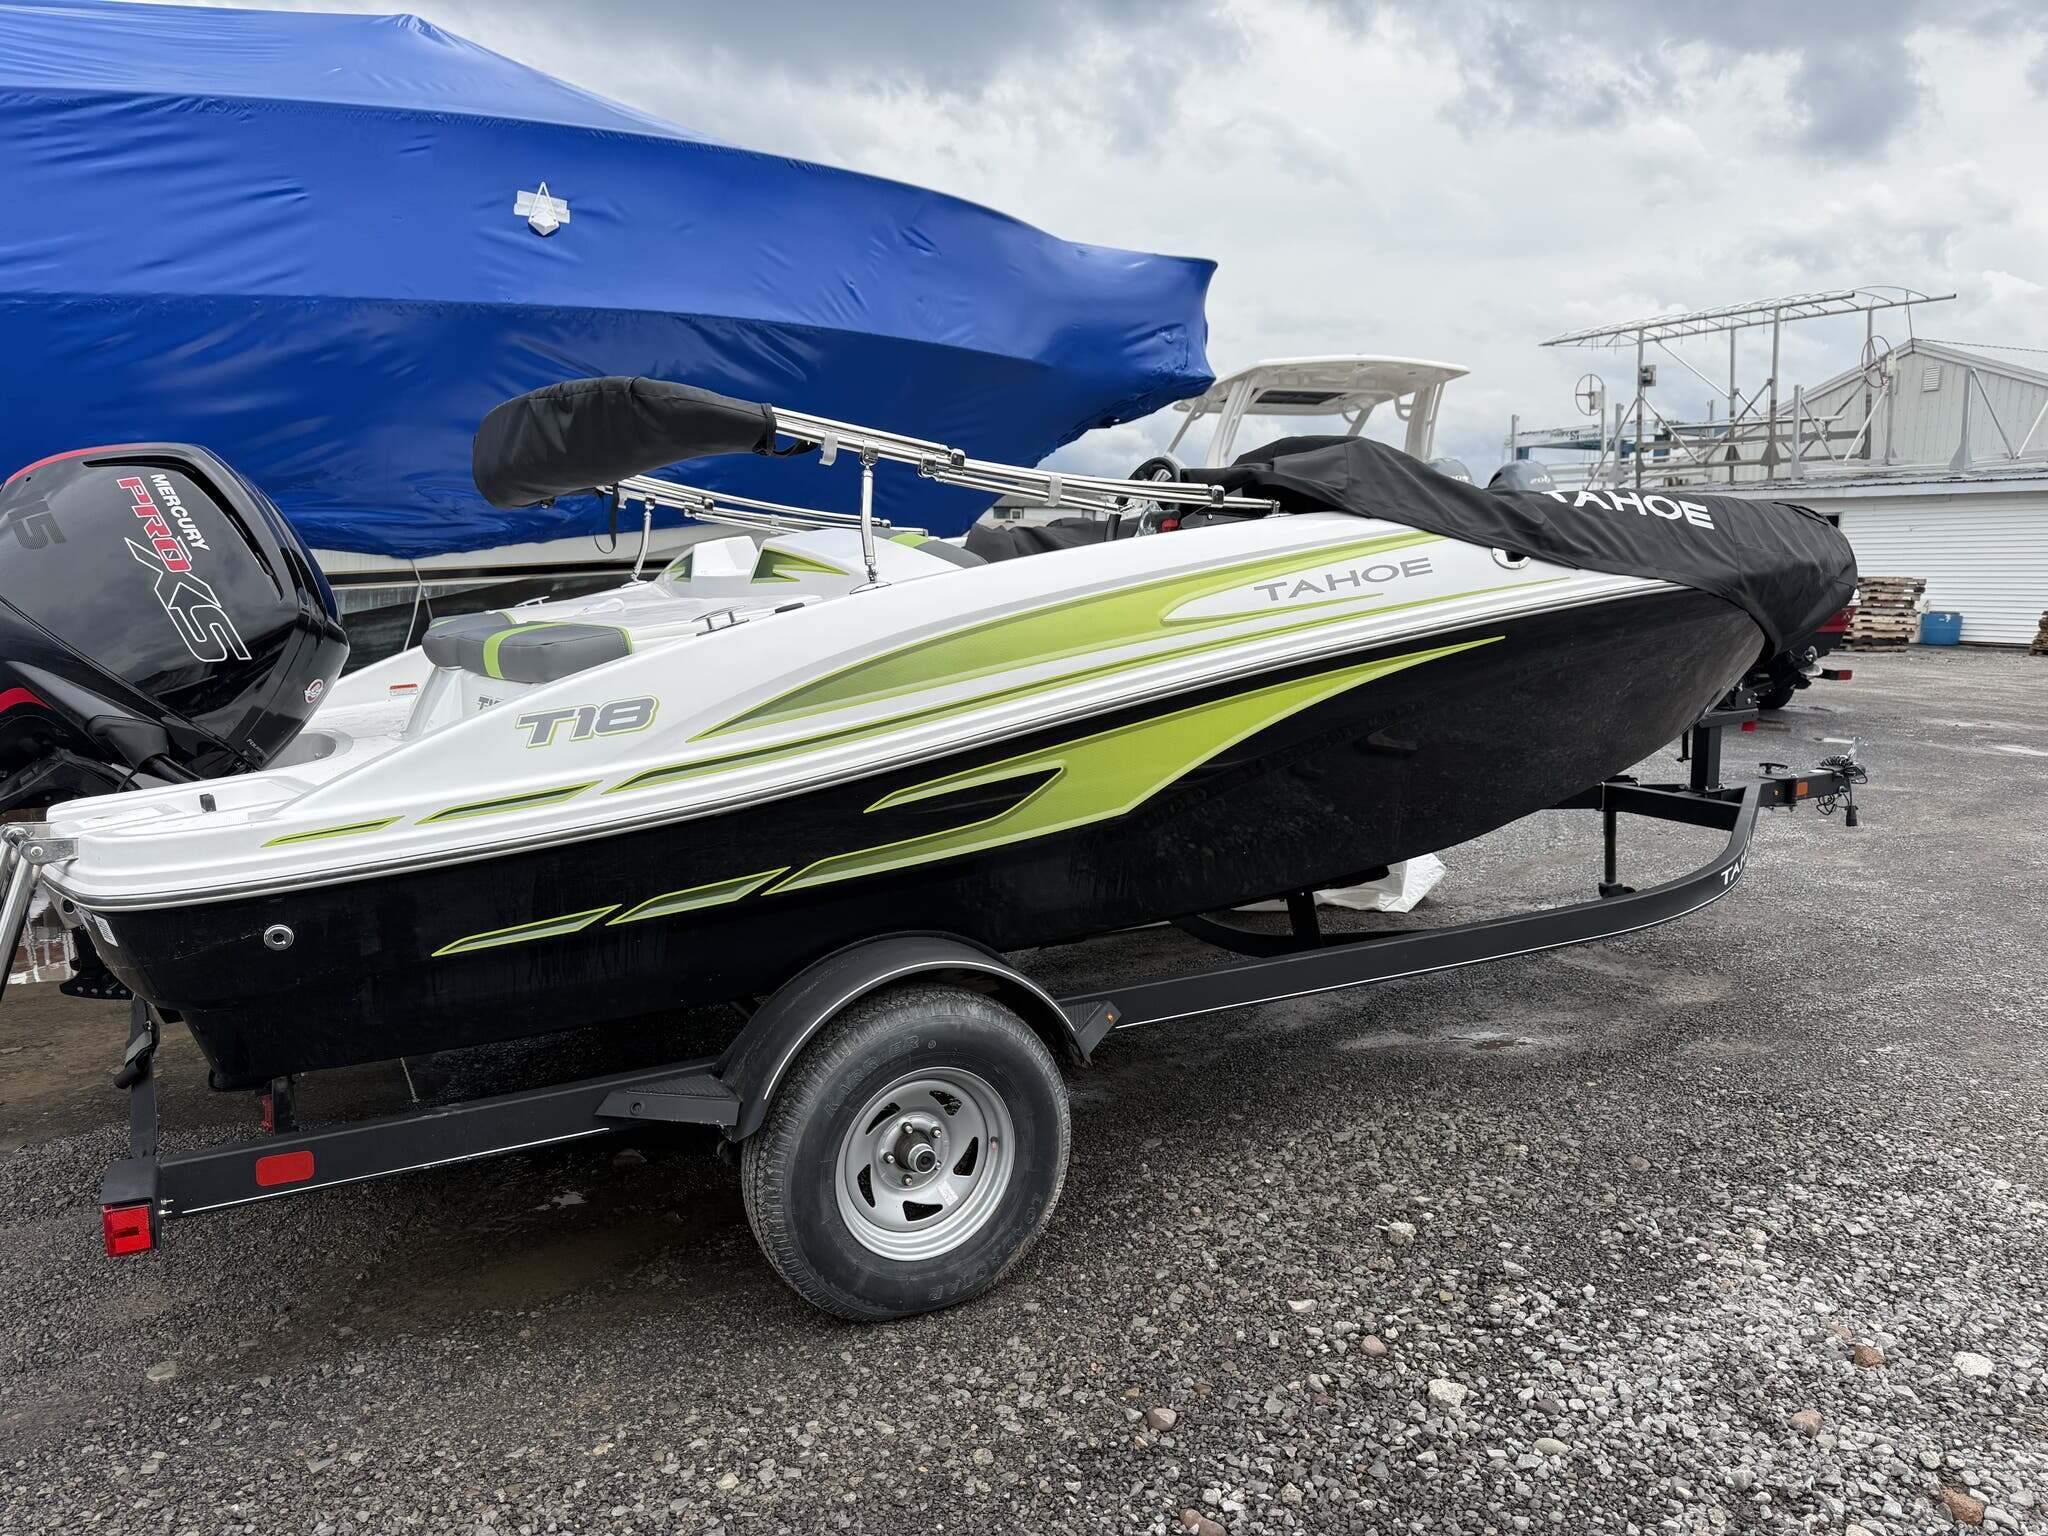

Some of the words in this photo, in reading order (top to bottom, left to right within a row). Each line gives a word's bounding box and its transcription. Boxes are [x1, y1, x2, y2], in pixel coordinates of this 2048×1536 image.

[116, 476, 192, 573] PRO
[150, 473, 211, 551] MERCURY
[1541, 489, 1716, 531] TAHOE
[124, 536, 253, 663] XS
[1253, 556, 1434, 602] TAHOE
[514, 694, 661, 750] T18
